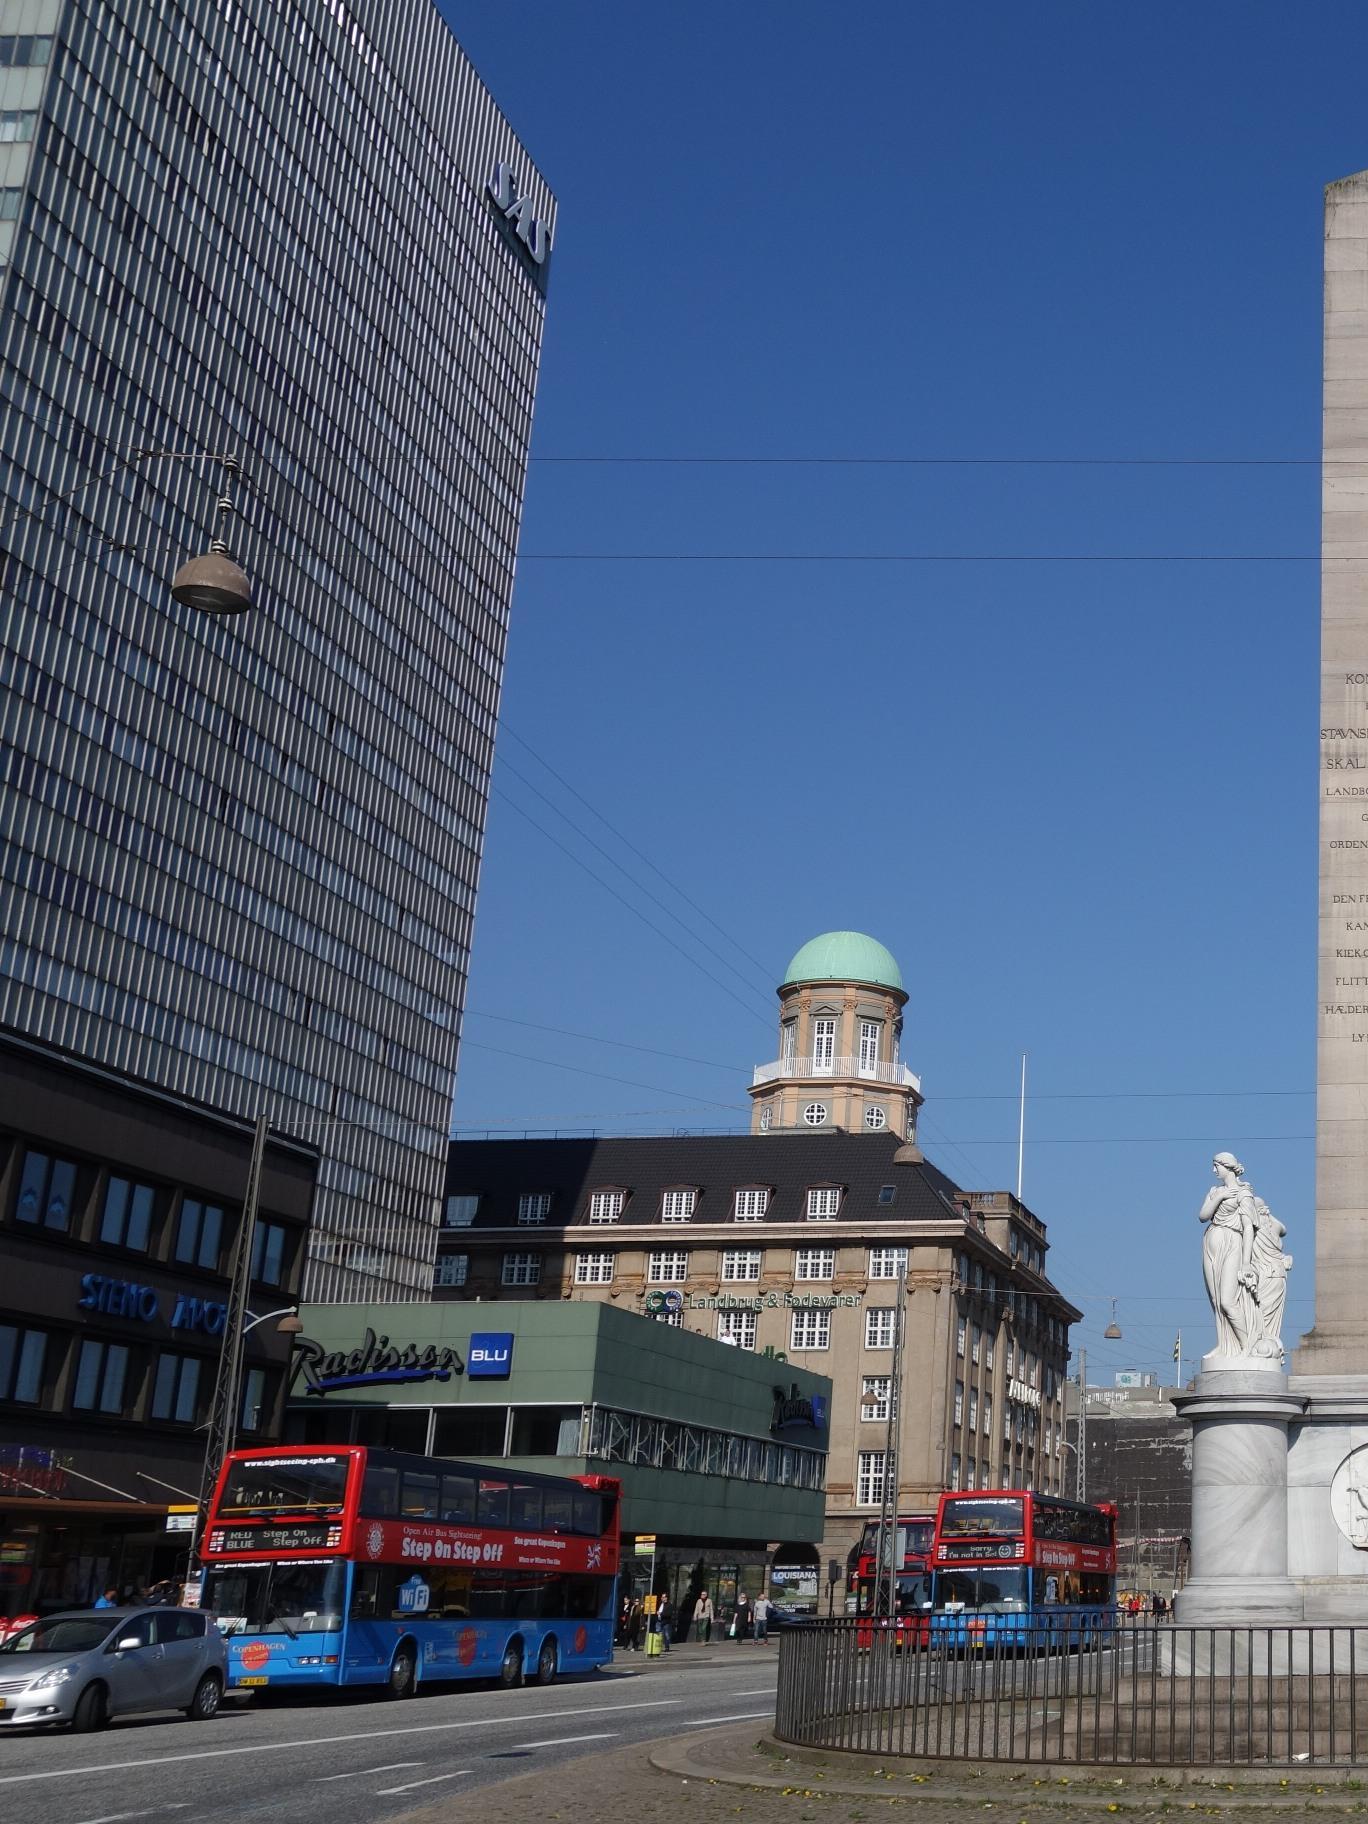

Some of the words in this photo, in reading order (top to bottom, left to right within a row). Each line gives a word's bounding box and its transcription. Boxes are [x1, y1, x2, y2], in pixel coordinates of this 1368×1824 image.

[488, 161, 553, 265] SAS
[1326, 759, 1366, 769] SKAL
[1329, 840, 1368, 849] ORDEN
[1333, 895, 1356, 904] DEN
[79, 1273, 159, 1323] STENO
[689, 1293, 765, 1311] Landbrug
[767, 1293, 780, 1308] &
[291, 1327, 465, 1393] Radisson
[471, 1349, 508, 1361] BLU
[244, 1457, 336, 1467] www.sightseeing-cph.dk
[230, 1531, 252, 1539] RED
[263, 1530, 289, 1539] Step
[293, 1529, 307, 1537] On
[403, 1527, 420, 1536] Open
[422, 1528, 434, 1536] Air
[435, 1529, 447, 1537] Bus
[226, 1540, 255, 1549] BLUE
[273, 1538, 299, 1547] Step
[402, 1537, 432, 1561] Step
[434, 1540, 452, 1558] On
[453, 1541, 480, 1564] Step
[483, 1543, 503, 1562] Off
[772, 1571, 817, 1580] LOUISIANA
